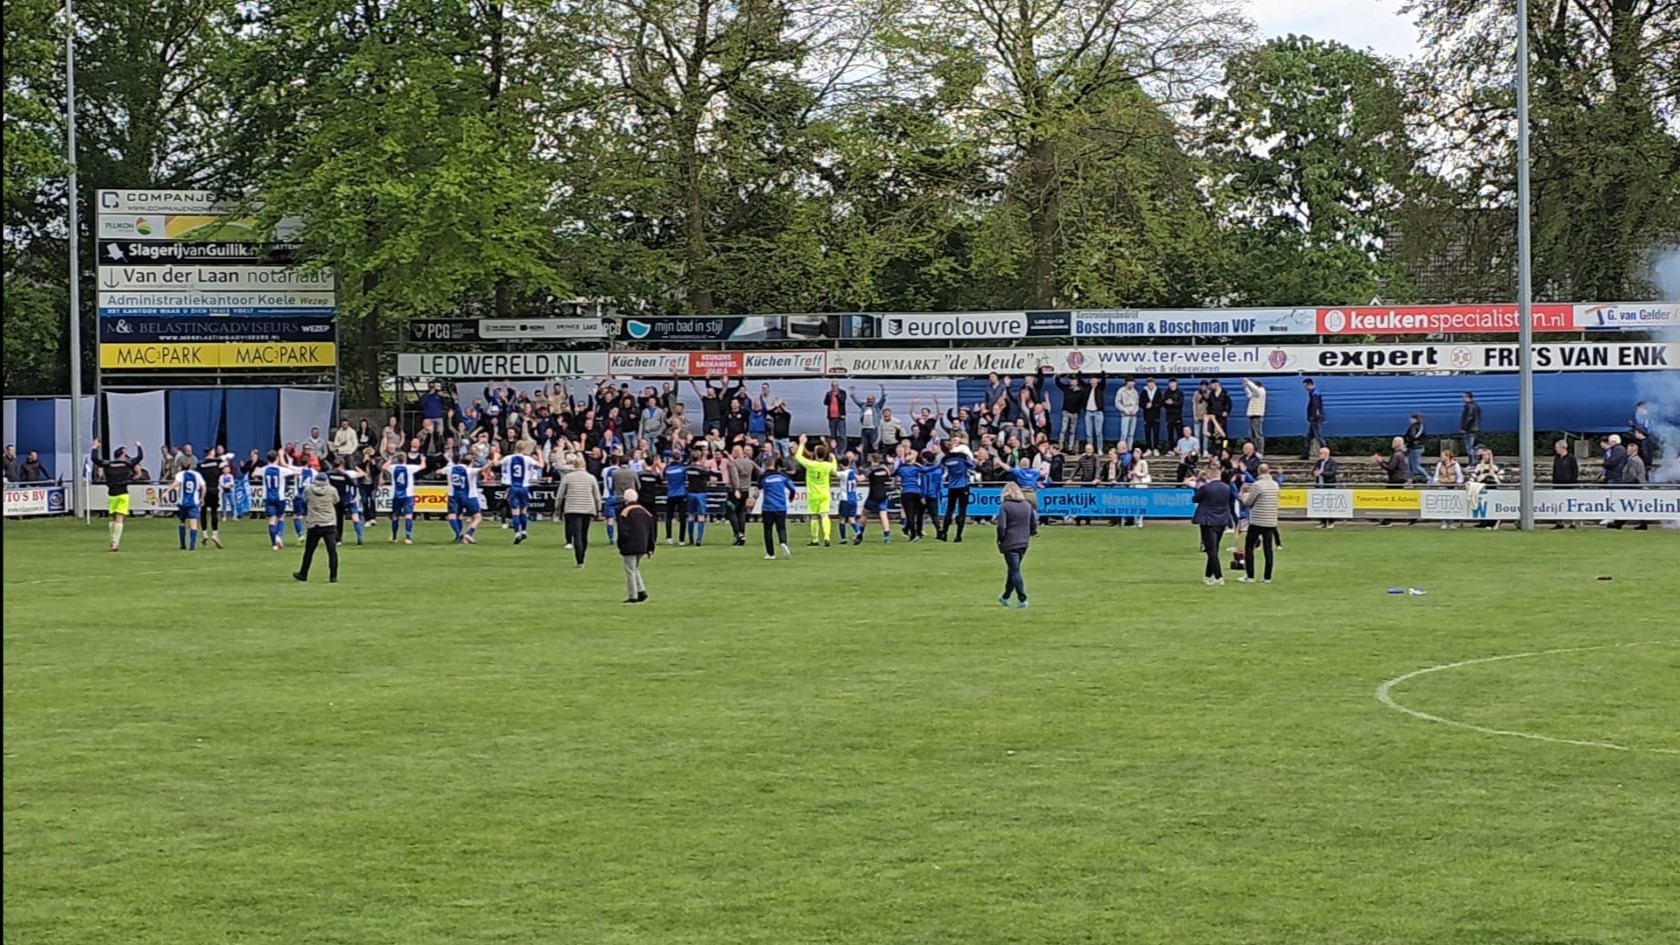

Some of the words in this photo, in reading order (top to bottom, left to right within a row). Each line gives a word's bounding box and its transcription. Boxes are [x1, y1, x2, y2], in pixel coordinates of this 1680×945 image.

[124, 268, 157, 283] Van
[163, 267, 192, 283] der
[198, 268, 239, 283] Laan
[247, 269, 328, 283] notariaat
[107, 295, 255, 306] Administratiekantoor
[258, 294, 296, 305] Koele
[1350, 309, 1567, 332] keukenspecialistn.nl
[1608, 309, 1617, 321] G.
[1620, 311, 1637, 321] van
[1640, 308, 1671, 320] Gelder
[140, 322, 298, 334] BELASTINGADVISEURS
[301, 325, 330, 333] WEZEP
[428, 323, 450, 340] PCG
[655, 319, 674, 335] mijn
[677, 319, 693, 332] bad
[695, 319, 704, 332] in
[706, 318, 724, 335] stijl
[908, 317, 1021, 336] eurolouvre
[1076, 320, 1144, 334] Boschman
[1147, 322, 1156, 334] &
[1160, 320, 1229, 334] Boschman
[1232, 318, 1256, 333] VOF
[1098, 347, 1259, 363] www.ter-weele.nl
[1318, 347, 1437, 370] expert
[1484, 347, 1551, 367] FRIS
[1559, 347, 1608, 367] VAN
[1618, 346, 1668, 367] ENK
[420, 354, 585, 375] LEDWERELD.NL
[852, 359, 941, 371] BOUWMARKT
[397, 472, 406, 486] 4
[513, 464, 523, 478] 3
[185, 481, 195, 494] 9
[266, 475, 278, 489] 11
[4, 490, 30, 503] TO'S
[32, 490, 46, 503] BV
[1043, 493, 1096, 508] praktijk
[1103, 495, 1148, 506] Nanne
[1495, 502, 1564, 516] Bouedrijf
[1566, 498, 1617, 513] Frank
